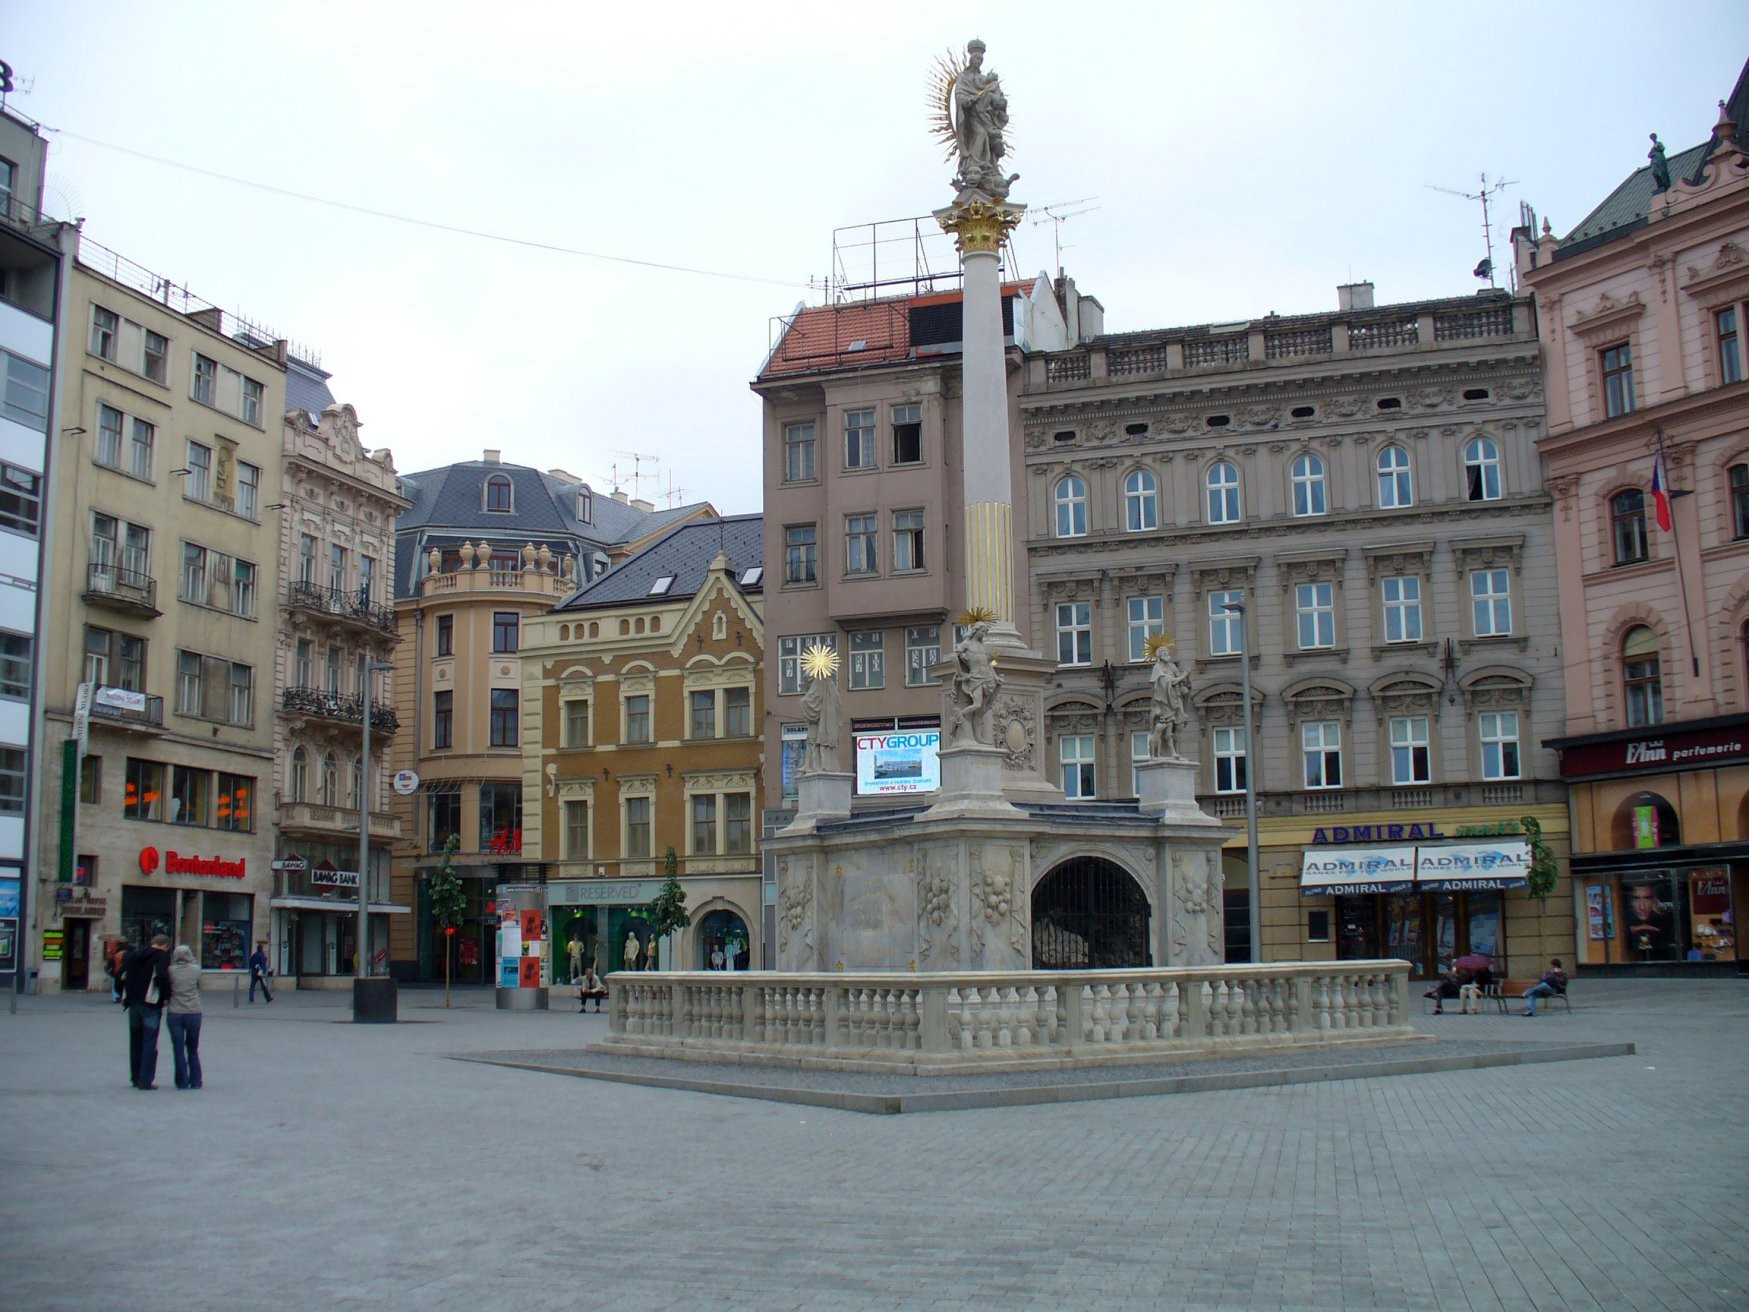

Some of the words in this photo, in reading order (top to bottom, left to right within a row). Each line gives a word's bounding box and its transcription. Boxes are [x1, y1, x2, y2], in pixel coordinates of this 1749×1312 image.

[1673, 742, 1742, 761] parfumerie
[1312, 822, 1444, 843] ADMIRAL
[282, 861, 304, 869] BAWAG
[1307, 859, 1413, 870] ADMIRAL
[1421, 854, 1530, 866] ADMIRAL
[313, 871, 338, 884] BAWAG
[339, 872, 358, 885] BANK
[1326, 883, 1387, 896] ADMIRAL
[1443, 879, 1506, 891] ADMIRAL
[579, 884, 639, 900] RESERVED
